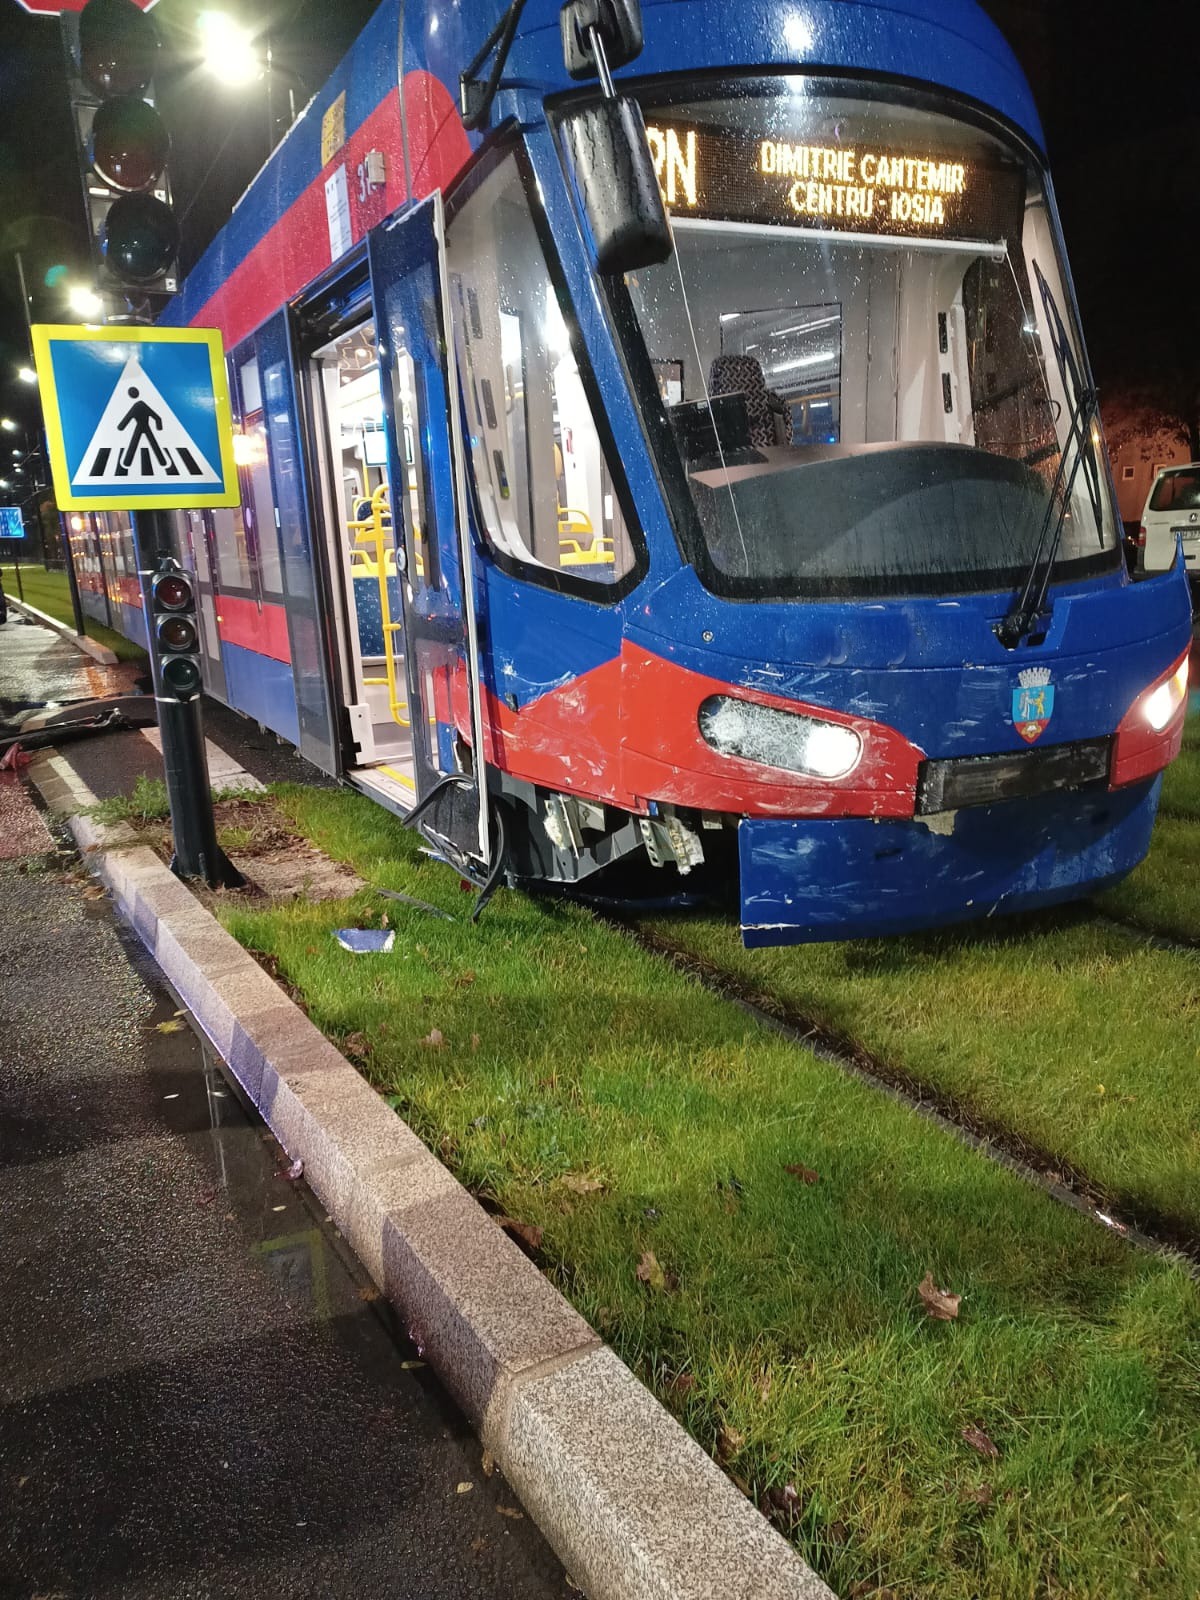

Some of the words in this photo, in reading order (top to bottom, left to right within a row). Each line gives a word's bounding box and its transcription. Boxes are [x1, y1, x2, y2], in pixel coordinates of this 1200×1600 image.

[760, 141, 855, 182] DIMITRIE
[860, 154, 966, 193] CANTEMIR
[788, 181, 874, 217] CENTRU
[891, 191, 945, 224] IOSIA
